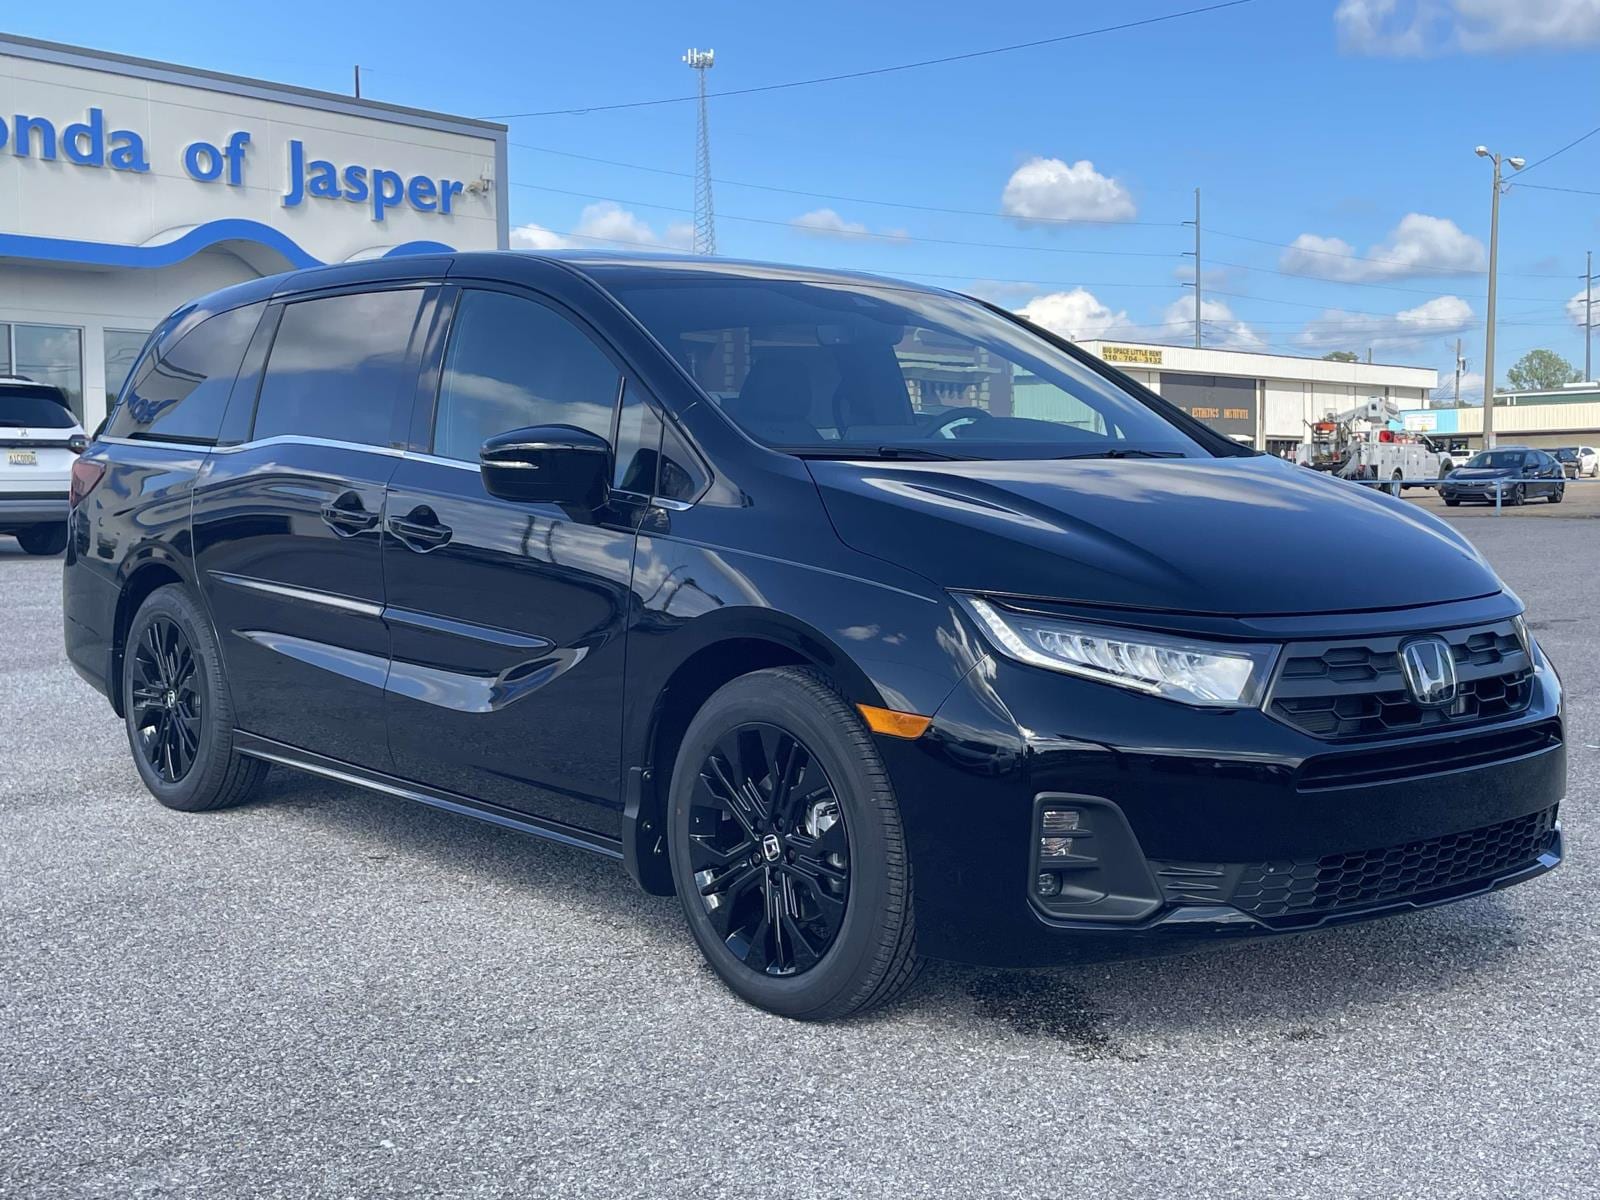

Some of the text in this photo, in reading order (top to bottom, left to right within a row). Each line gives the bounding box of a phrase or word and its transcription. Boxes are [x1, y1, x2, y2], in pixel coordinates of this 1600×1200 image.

[0, 107, 464, 221] nda of Jasper
[1113, 347, 1130, 355] SPACE
[1130, 348, 1148, 356] LITTLE
